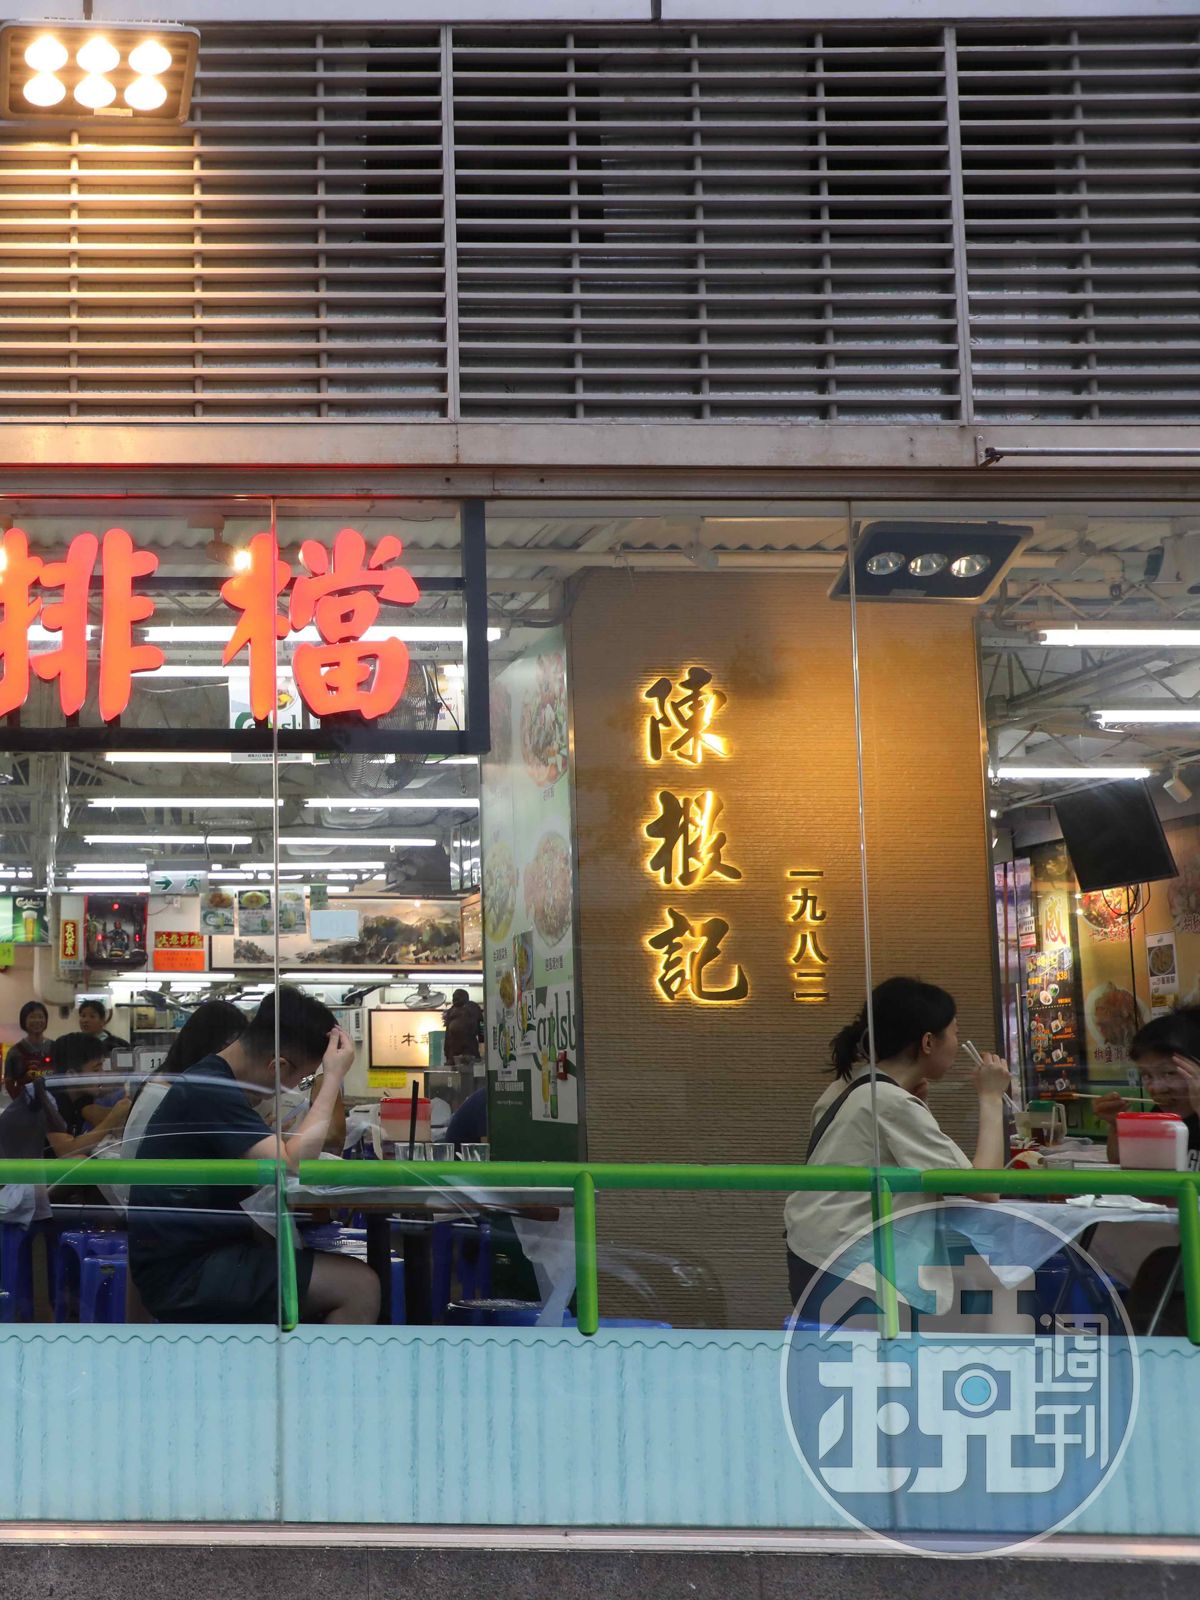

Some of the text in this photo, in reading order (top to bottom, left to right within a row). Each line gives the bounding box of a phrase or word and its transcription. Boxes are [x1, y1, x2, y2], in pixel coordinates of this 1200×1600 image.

[643, 665, 749, 1003] 陳根記
[787, 869, 831, 1002] 一九八二
